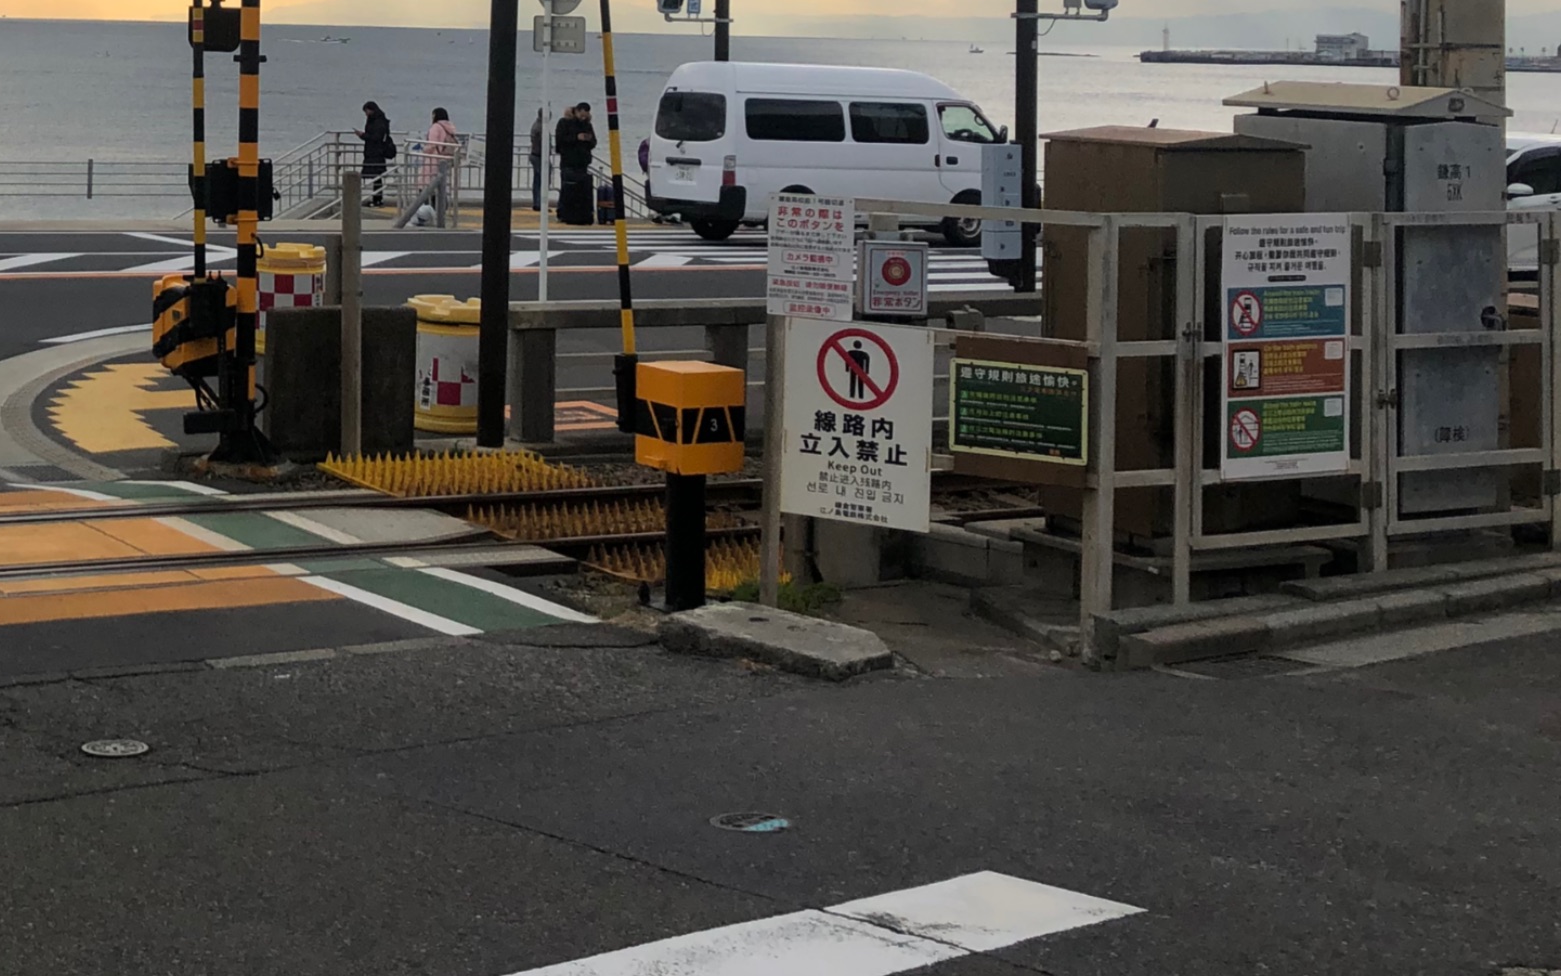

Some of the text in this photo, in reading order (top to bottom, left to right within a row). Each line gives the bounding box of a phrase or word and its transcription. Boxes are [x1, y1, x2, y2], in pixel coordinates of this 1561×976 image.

[778, 206, 842, 219] 非常の際は
[777, 218, 844, 232] このボタンを
[1229, 227, 1249, 235] Follow
[1251, 227, 1261, 235] the
[1279, 226, 1288, 234] for
[1295, 226, 1309, 234] safe
[1310, 226, 1322, 234] and
[1323, 226, 1333, 234] fun
[872, 297, 921, 308] 非常ボタン
[710, 418, 718, 432] 3
[814, 410, 894, 440] 線路内
[799, 433, 908, 466] 立入禁止
[828, 460, 883, 476] Keep Out
[807, 481, 904, 505] 선로 내 진입 금지
